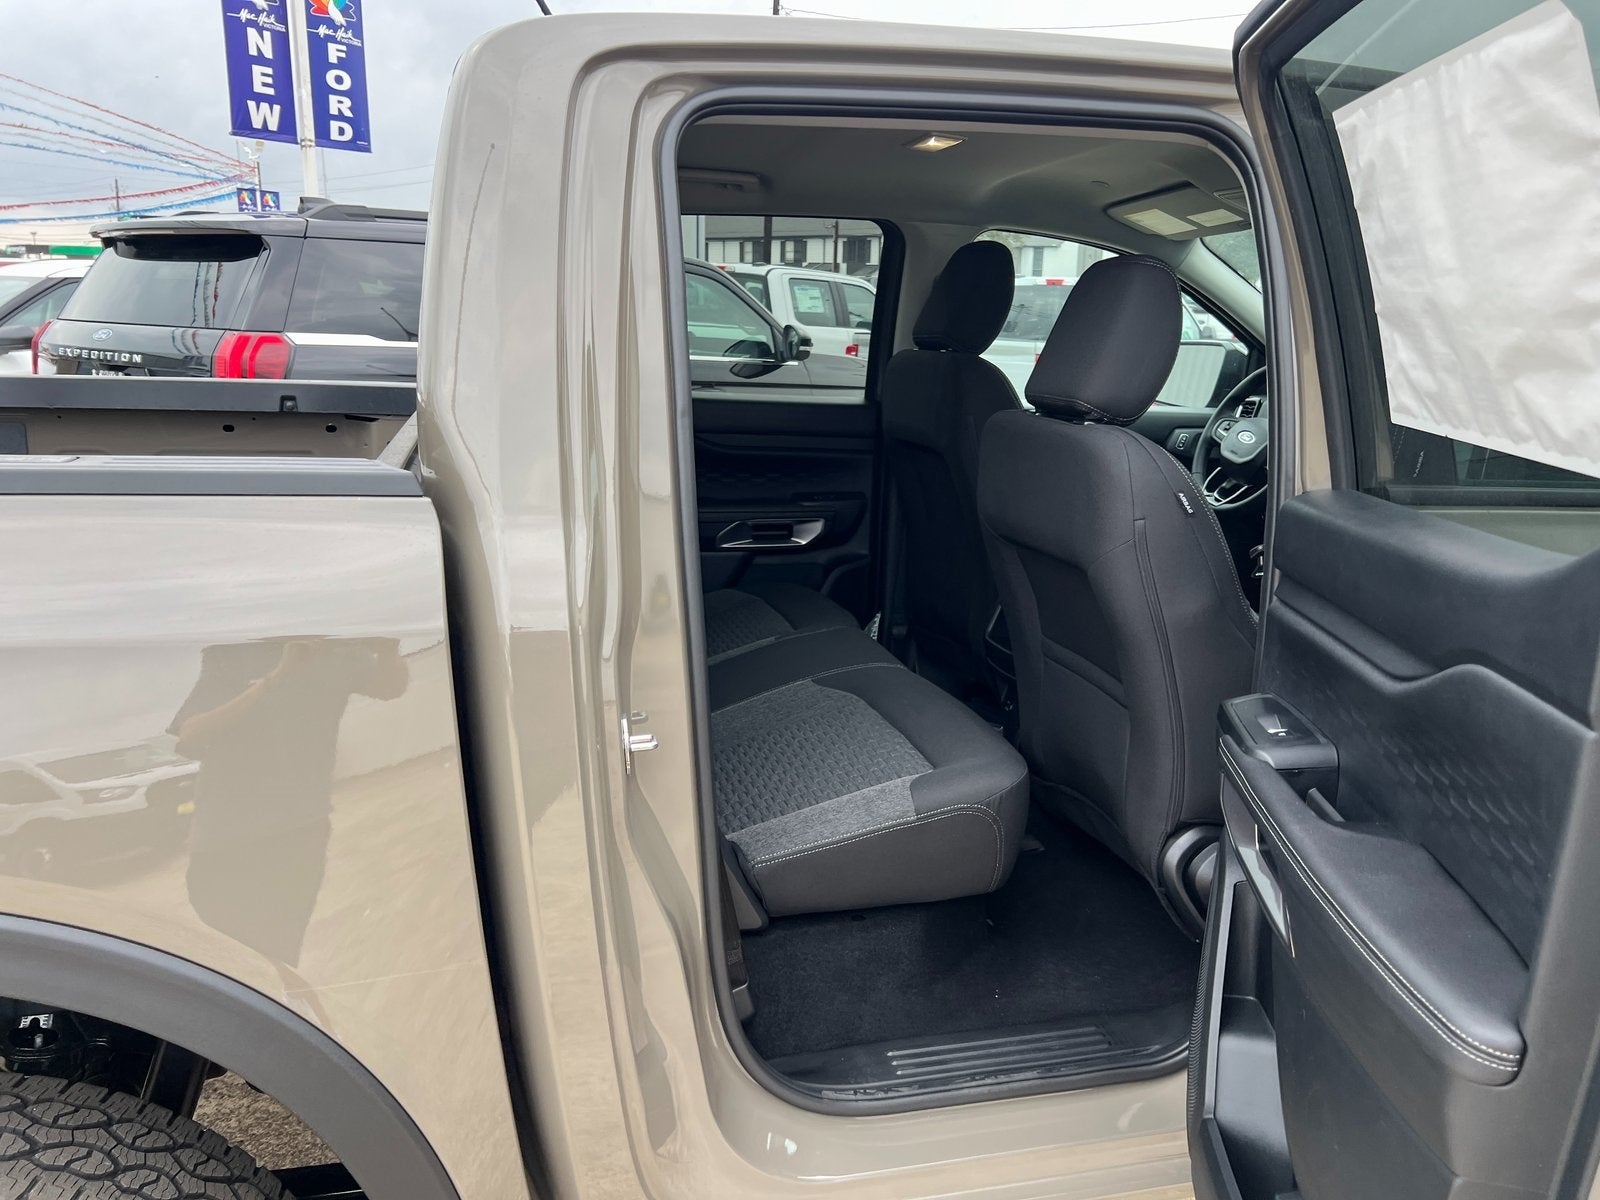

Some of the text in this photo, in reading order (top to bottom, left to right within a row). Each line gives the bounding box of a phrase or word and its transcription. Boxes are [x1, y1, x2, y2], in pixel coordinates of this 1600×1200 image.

[227, 8, 285, 26] Mac Haik
[307, 24, 361, 41] Mac Haik
[246, 27, 281, 131] NEW
[325, 42, 353, 142] FORD
[58, 347, 142, 363] EXPEDITION
[1178, 492, 1194, 513] AIRBAG
